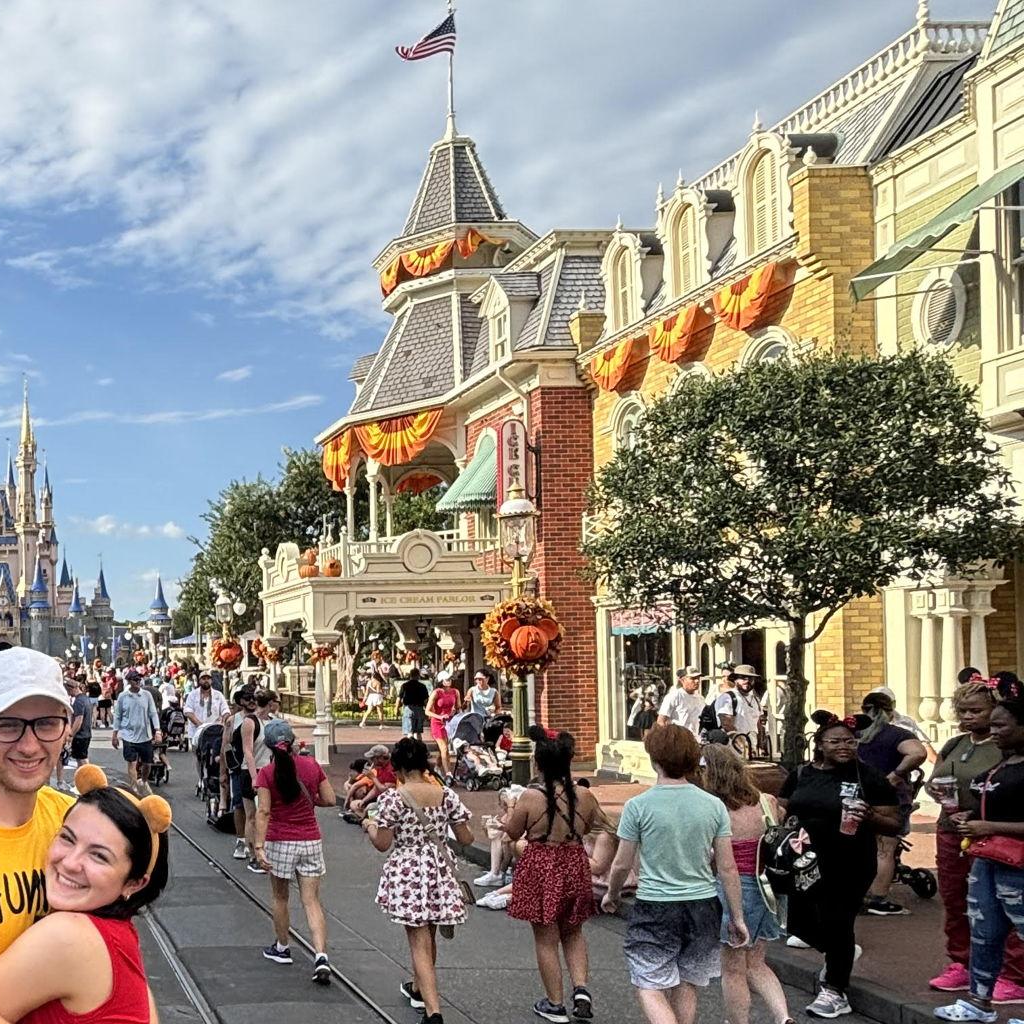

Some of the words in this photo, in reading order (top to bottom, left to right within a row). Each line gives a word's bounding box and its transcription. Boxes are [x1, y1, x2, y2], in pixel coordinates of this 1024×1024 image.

[507, 423, 520, 460] ICE
[400, 596, 434, 604] CREAM
[437, 595, 477, 603] PARLOR
